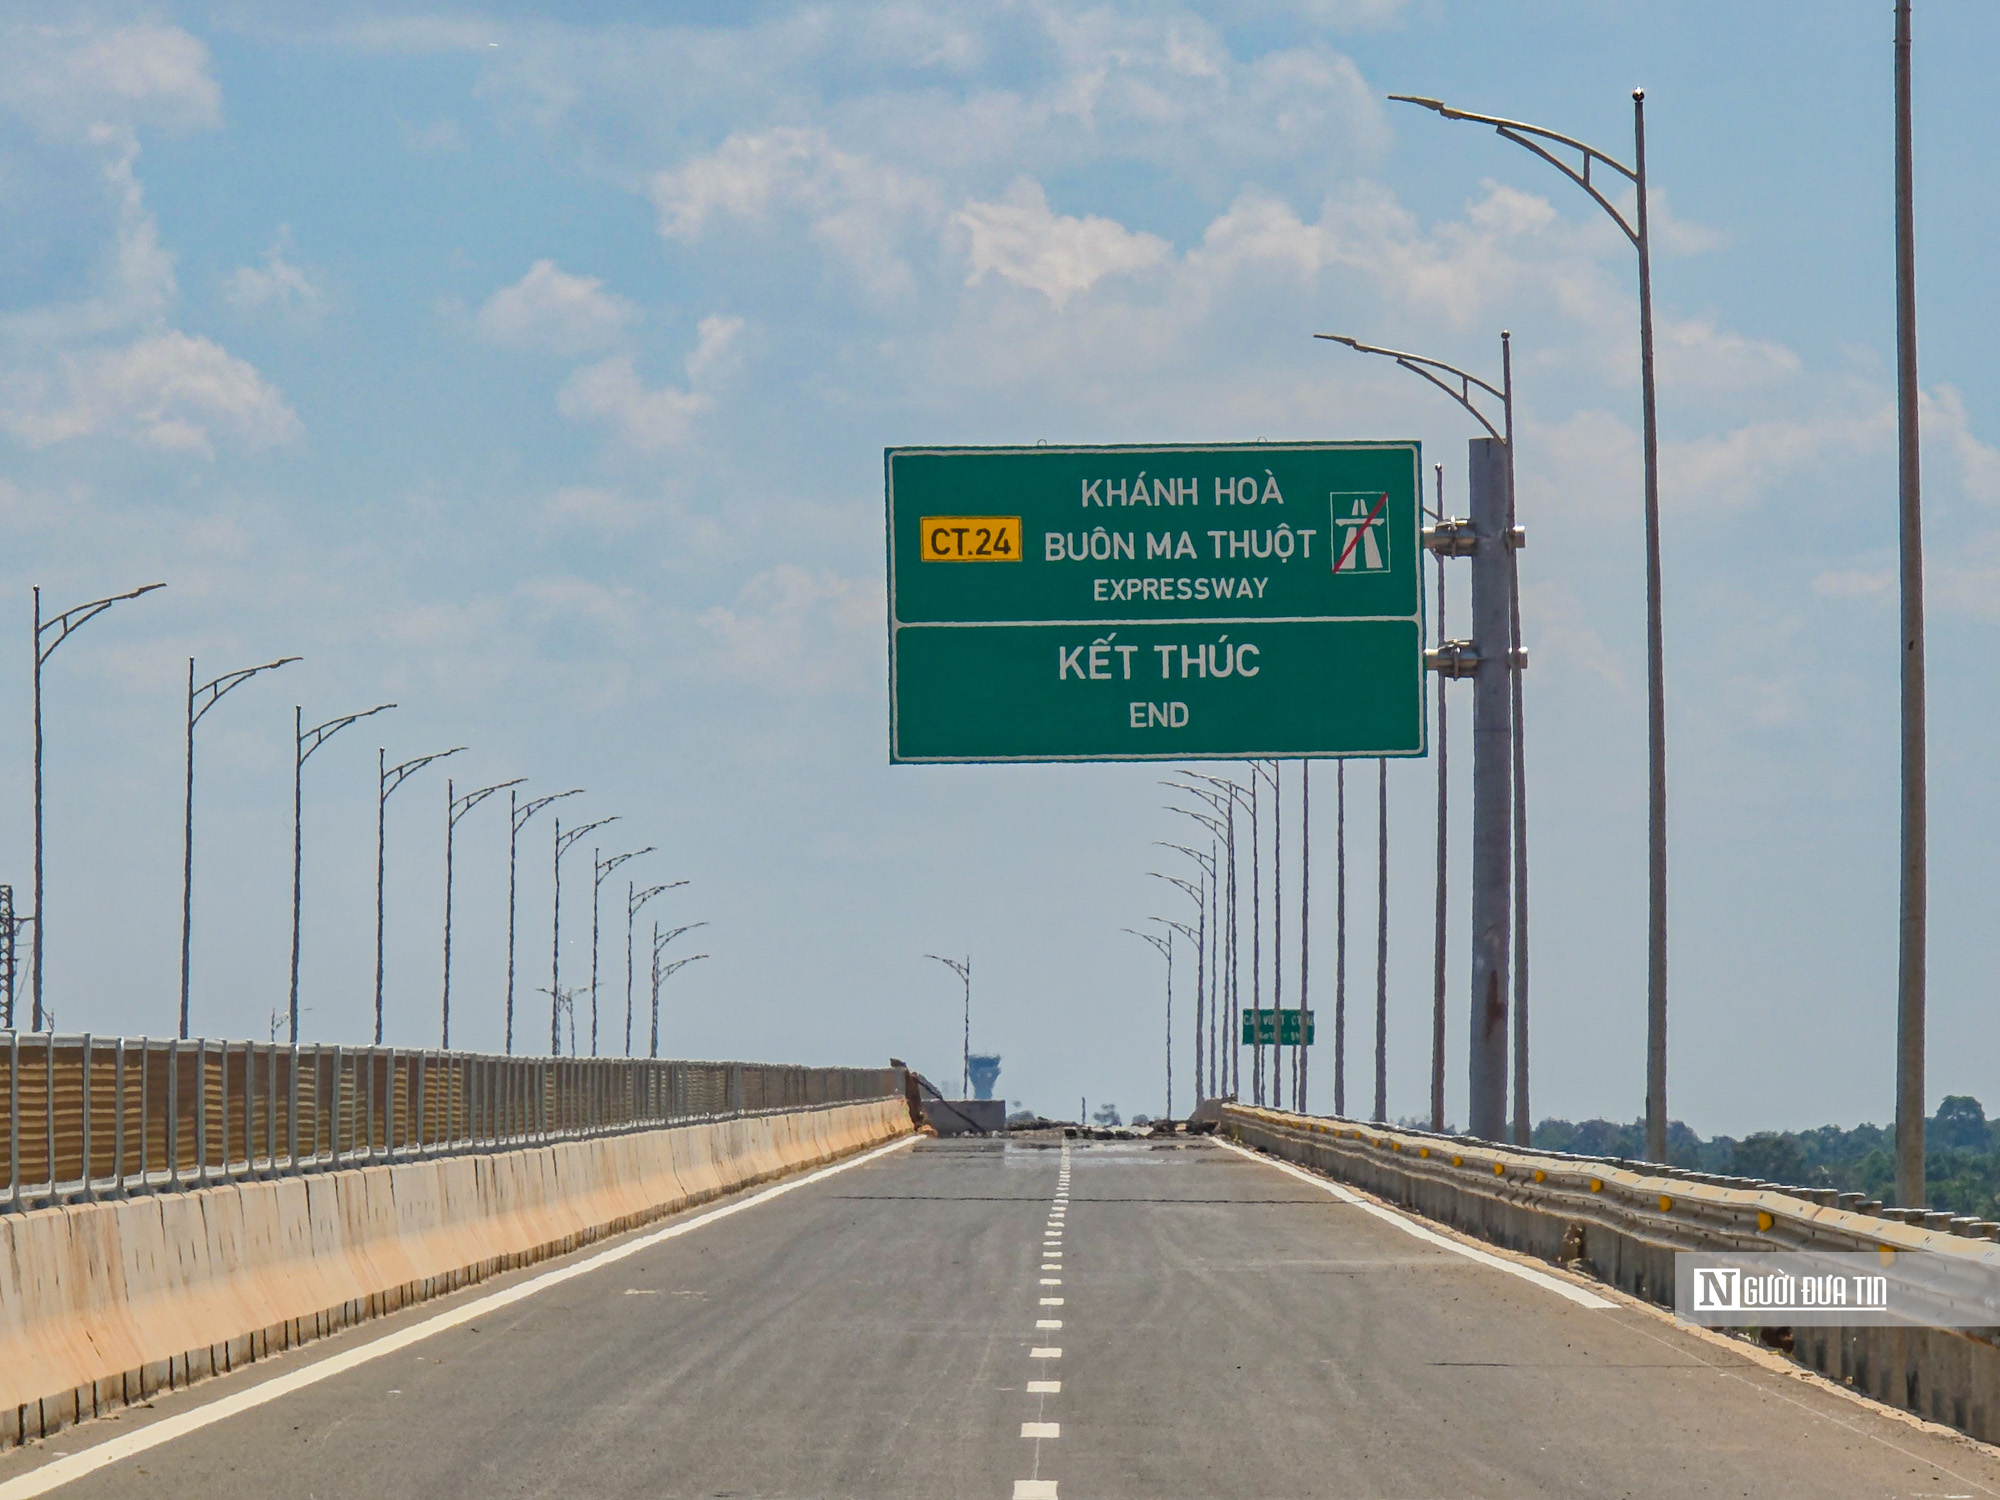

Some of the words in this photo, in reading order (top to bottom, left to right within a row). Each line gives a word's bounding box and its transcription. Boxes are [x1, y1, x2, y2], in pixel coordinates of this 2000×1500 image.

[1081, 471, 1198, 508] KHÁNH
[1214, 469, 1284, 506] HOÀ
[930, 527, 1012, 556] CT.24
[1045, 526, 1135, 562] BUÔN
[1146, 531, 1198, 560] MA
[1207, 522, 1317, 564] THUỘT
[1093, 577, 1269, 601] EXPRESSWAY
[1059, 632, 1139, 681] KẾT
[1153, 634, 1260, 679] THÚC
[1129, 701, 1189, 728] END
